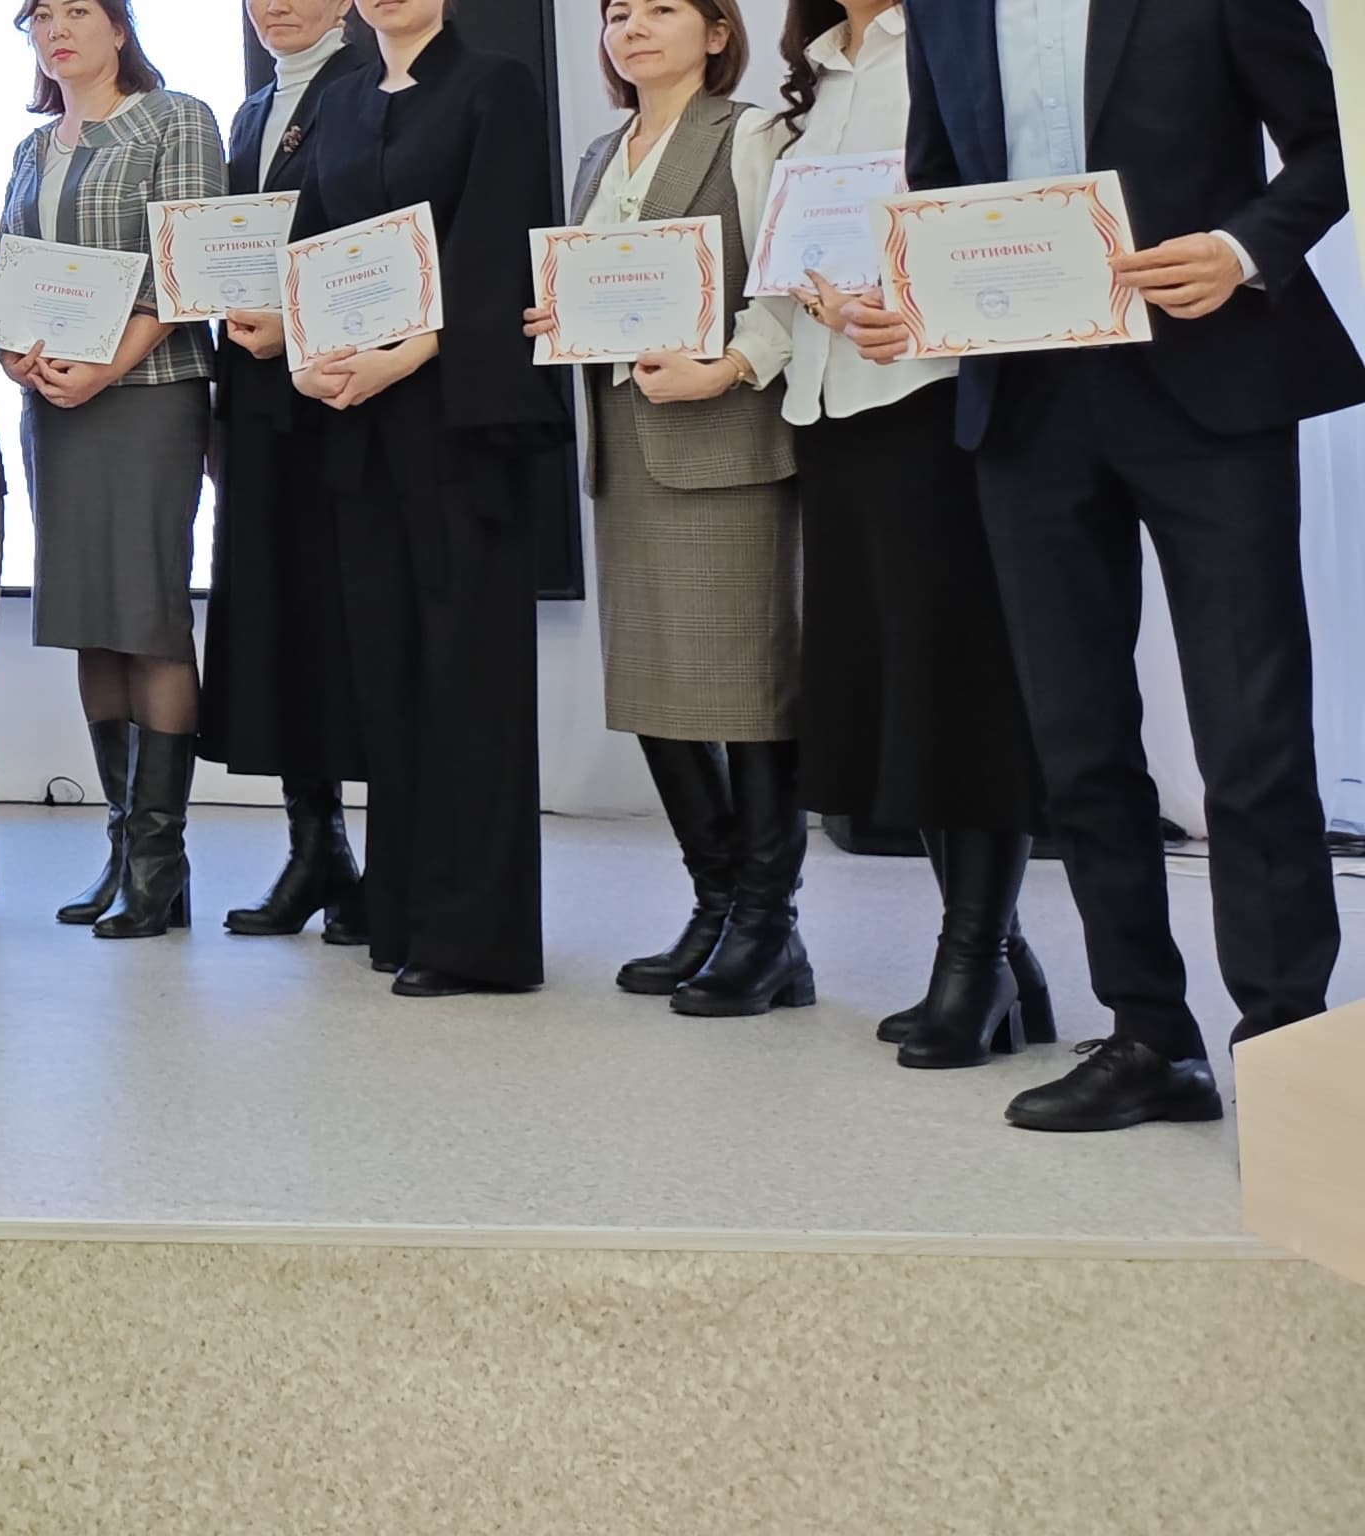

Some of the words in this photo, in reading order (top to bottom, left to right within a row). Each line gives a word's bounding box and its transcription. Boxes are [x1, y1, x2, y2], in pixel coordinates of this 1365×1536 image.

[950, 241, 1054, 262] СЕРТИФИКАТ
[325, 264, 390, 290] СЕРТИФИКАТ
[588, 271, 667, 285] СЕРТИФИКАТ
